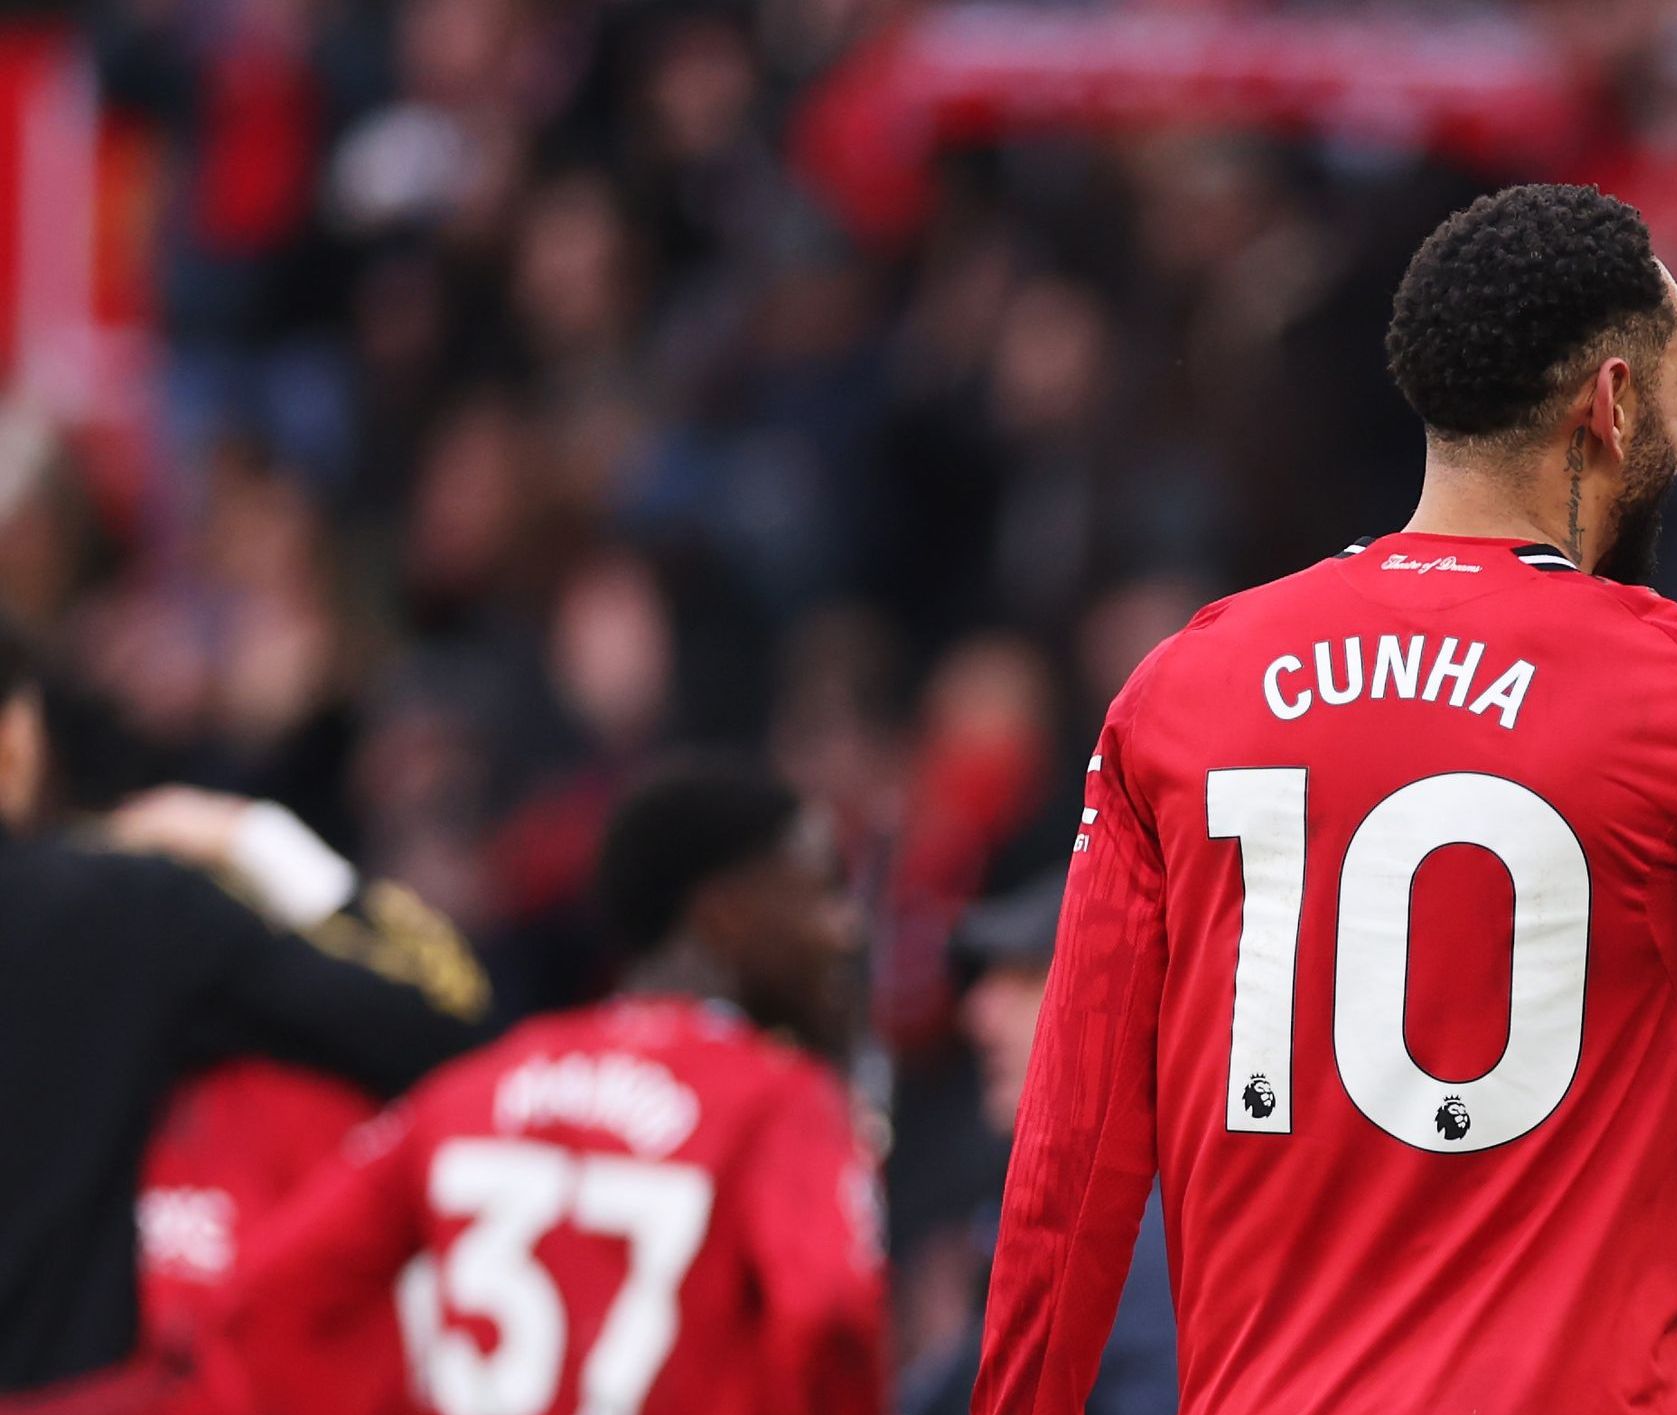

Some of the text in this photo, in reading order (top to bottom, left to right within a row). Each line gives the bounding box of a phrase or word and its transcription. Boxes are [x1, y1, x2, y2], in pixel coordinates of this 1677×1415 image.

[1417, 557, 1442, 575] of
[1435, 555, 1483, 574] Dreams
[1262, 634, 1537, 730] CUNHA
[1205, 765, 1592, 1154] 10
